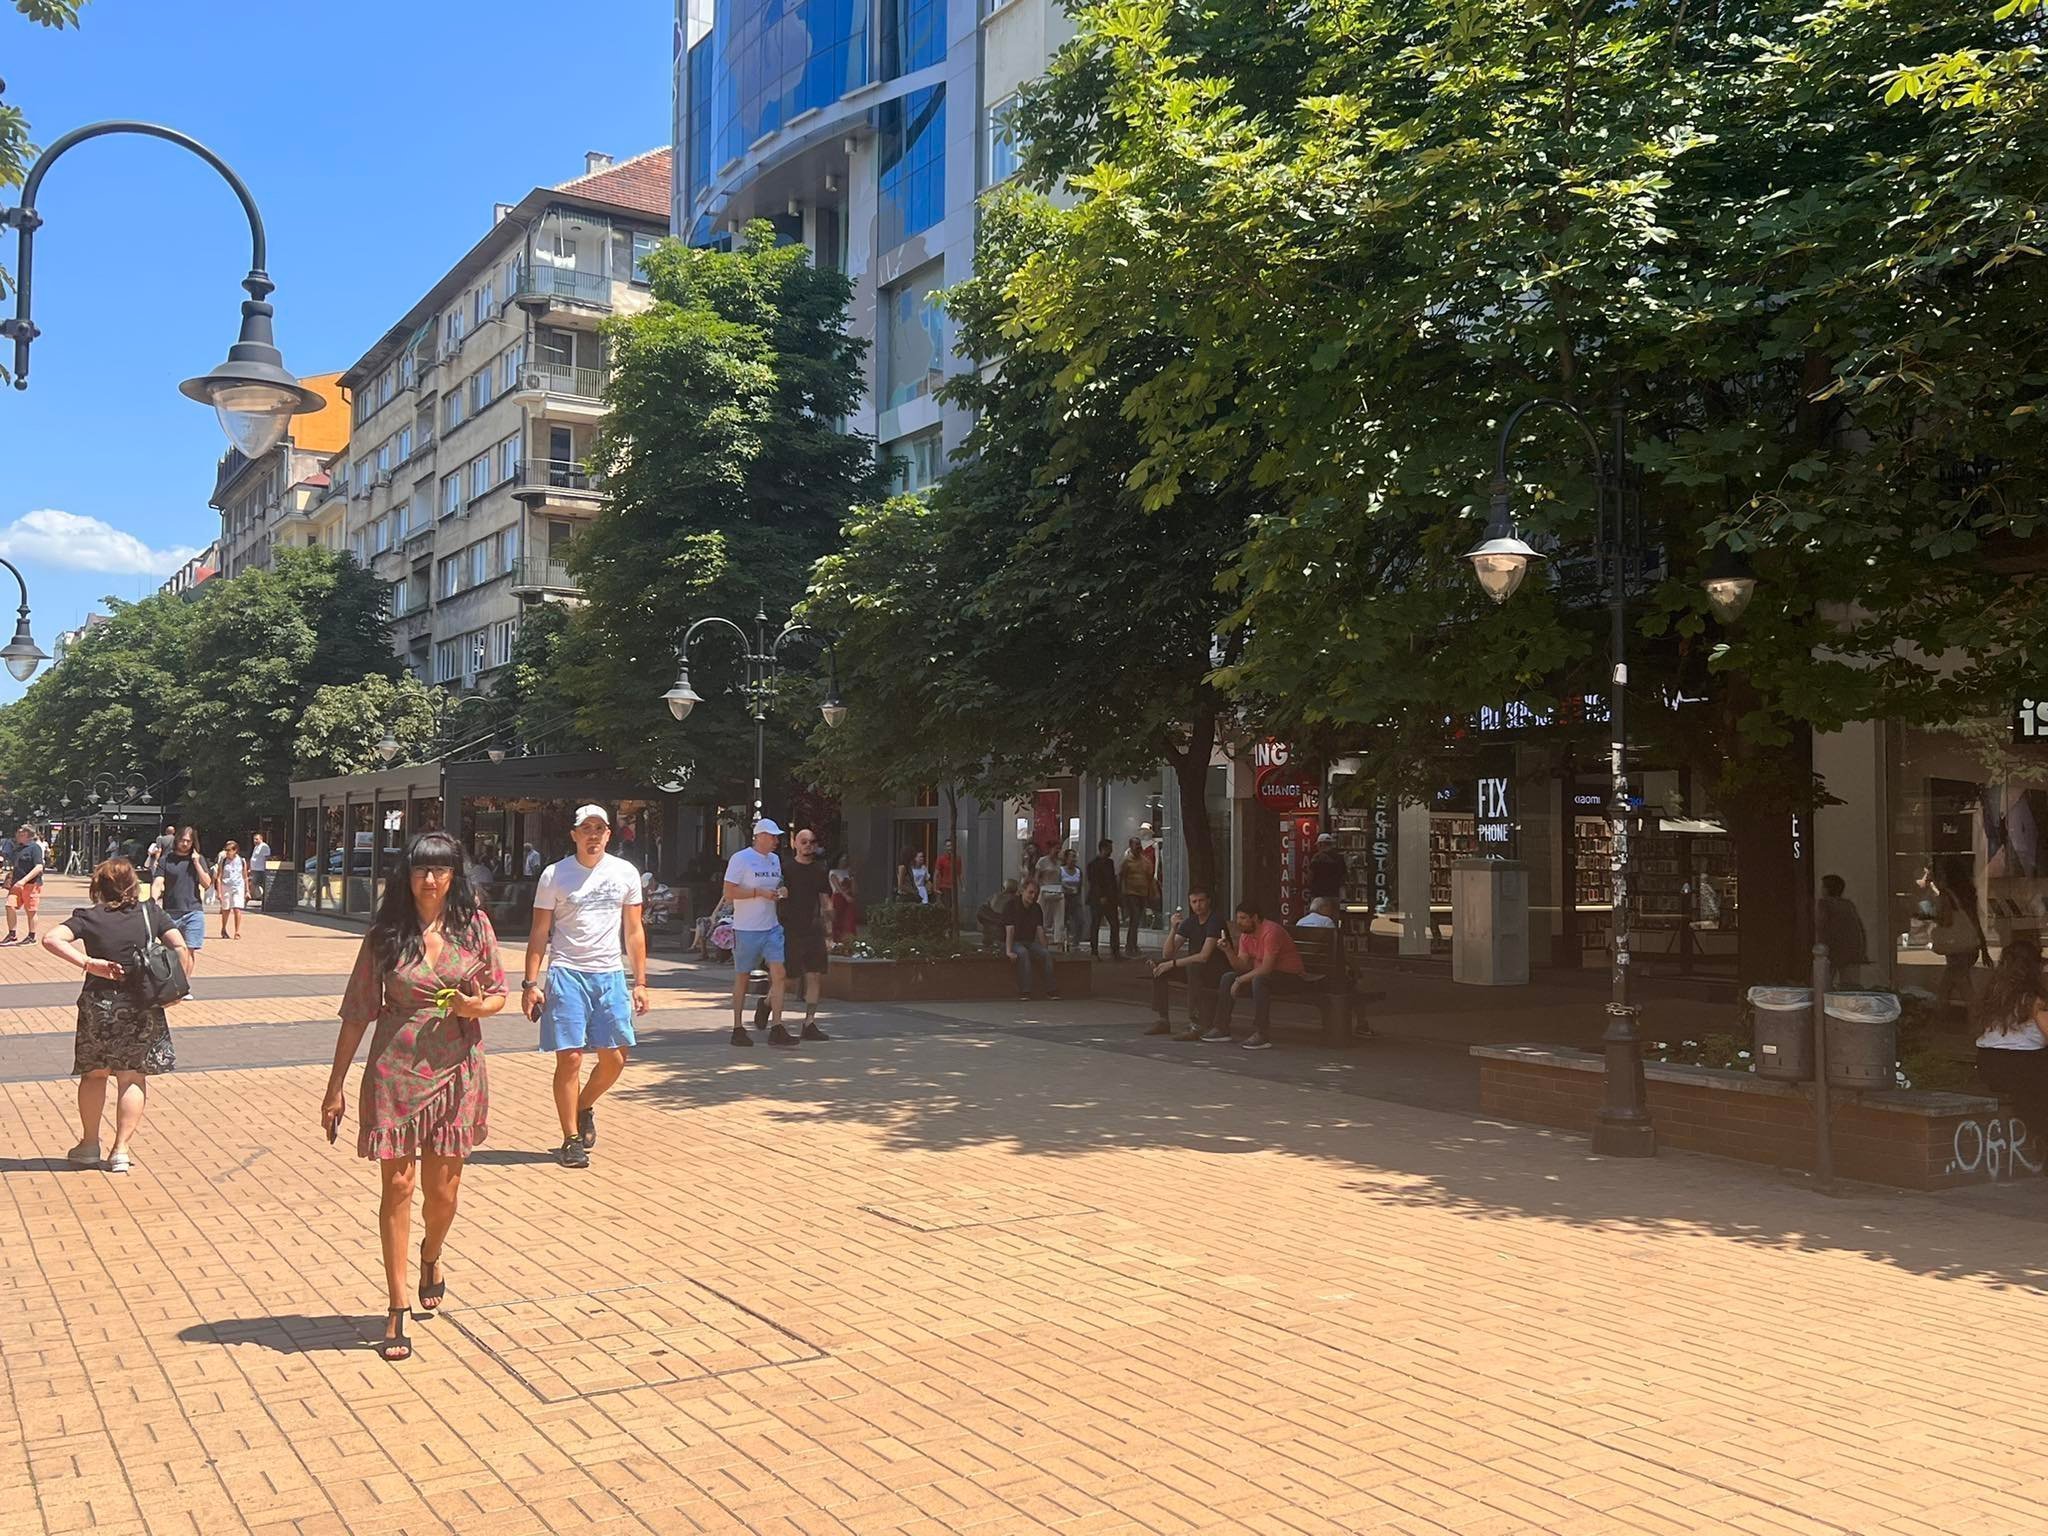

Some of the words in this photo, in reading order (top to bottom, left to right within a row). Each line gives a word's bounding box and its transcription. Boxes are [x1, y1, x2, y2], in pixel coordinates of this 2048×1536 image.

[1262, 784, 1301, 796] CHANGE
[1478, 778, 1508, 817] FIX
[1478, 823, 1509, 841] PHONE
[1302, 822, 1312, 917] CHANG
